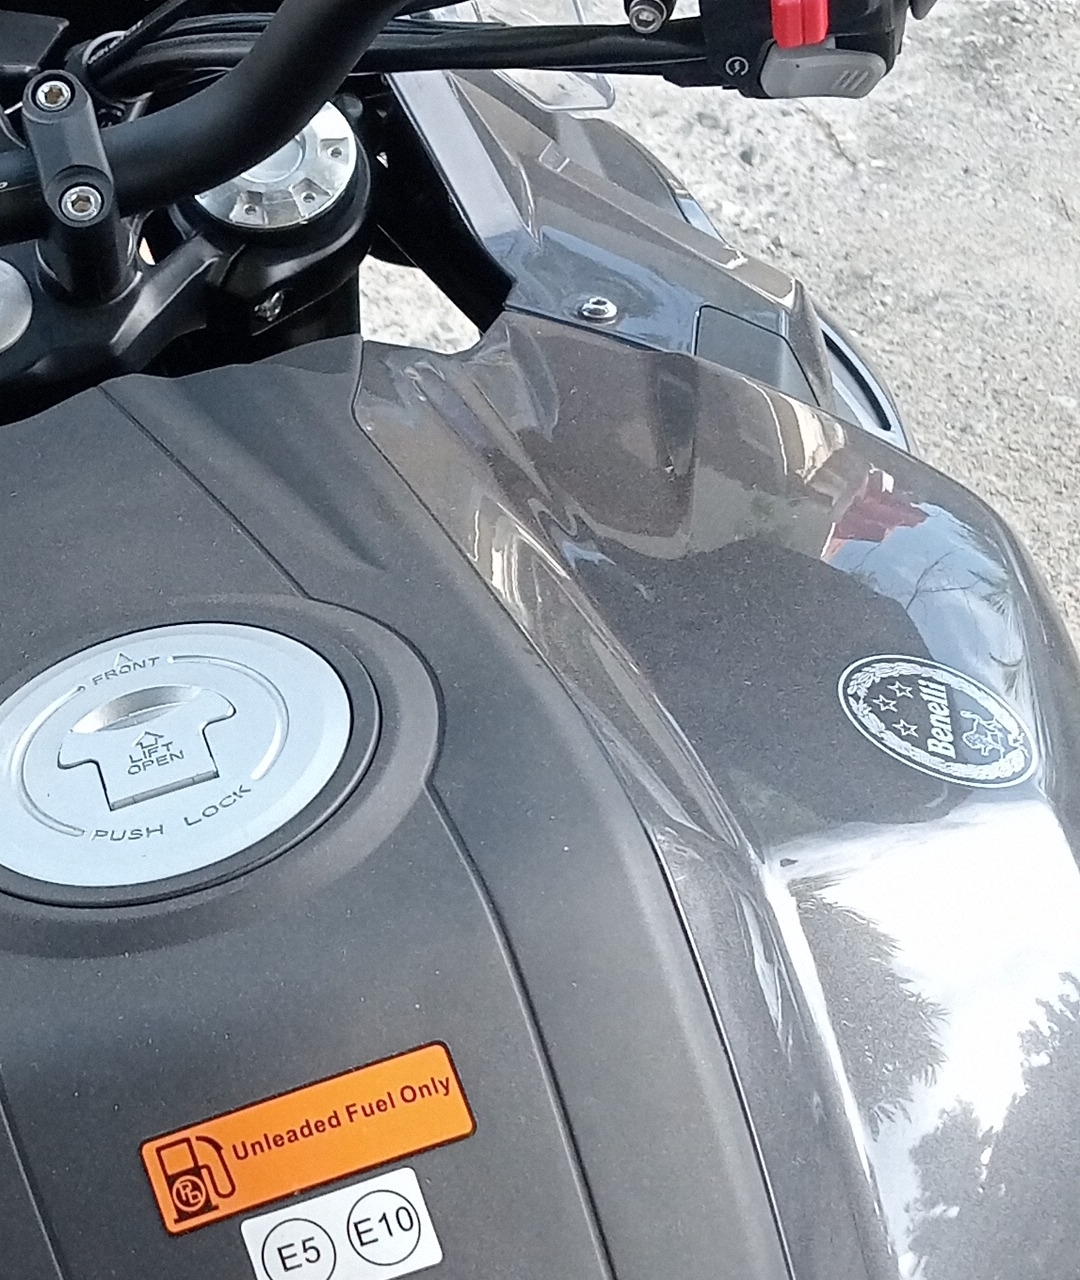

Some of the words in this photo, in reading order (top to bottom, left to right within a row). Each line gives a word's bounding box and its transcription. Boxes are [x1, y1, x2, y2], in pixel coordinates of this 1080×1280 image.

[92, 656, 160, 686] FRONT
[918, 679, 956, 759] Benelli
[126, 749, 186, 776] OPEN
[127, 741, 174, 764] LIFT
[91, 824, 165, 842] PUSH
[183, 784, 252, 827] LOCK
[232, 1109, 342, 1161] Unleaded
[345, 1091, 396, 1123] Fuel
[400, 1076, 450, 1104] Only
[276, 1236, 322, 1273] E5
[353, 1206, 415, 1247] E10
